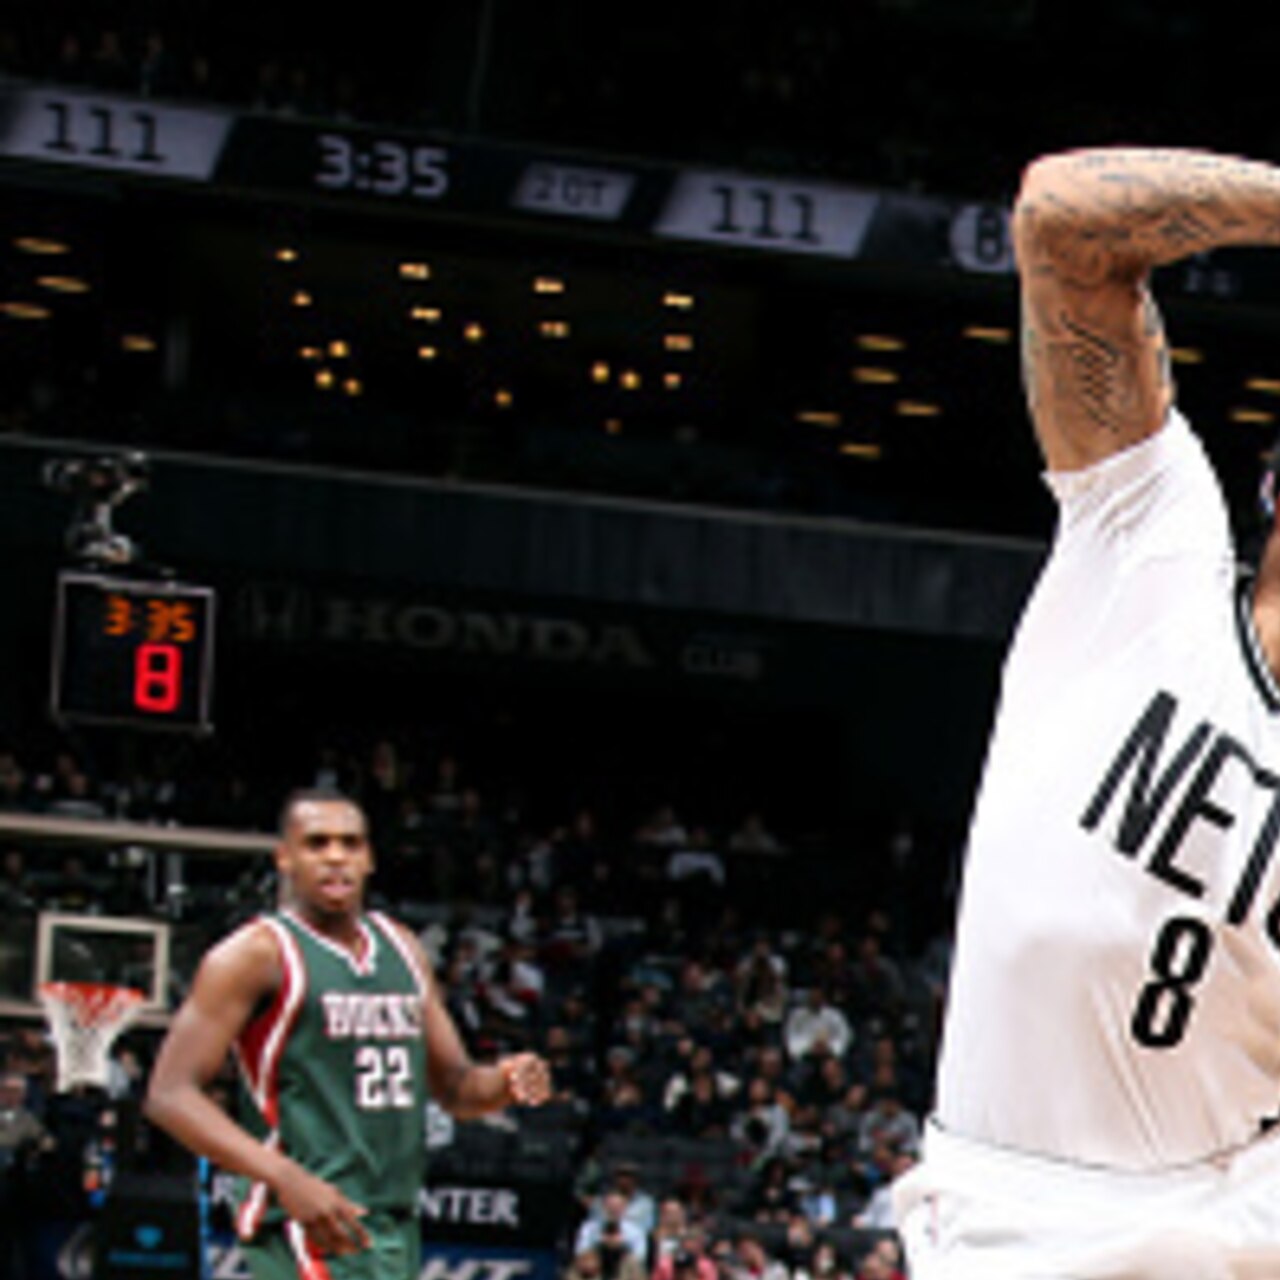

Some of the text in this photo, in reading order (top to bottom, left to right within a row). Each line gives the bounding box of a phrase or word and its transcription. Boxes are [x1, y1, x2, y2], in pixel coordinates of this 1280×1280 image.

[43, 101, 168, 163] 111
[314, 134, 450, 197] 3:35
[709, 184, 822, 246] 111
[323, 598, 656, 671] HONDA
[133, 641, 182, 713] 8
[1131, 916, 1213, 1048] 8
[355, 1046, 414, 1109] 22
[415, 1186, 520, 1230] NTER
